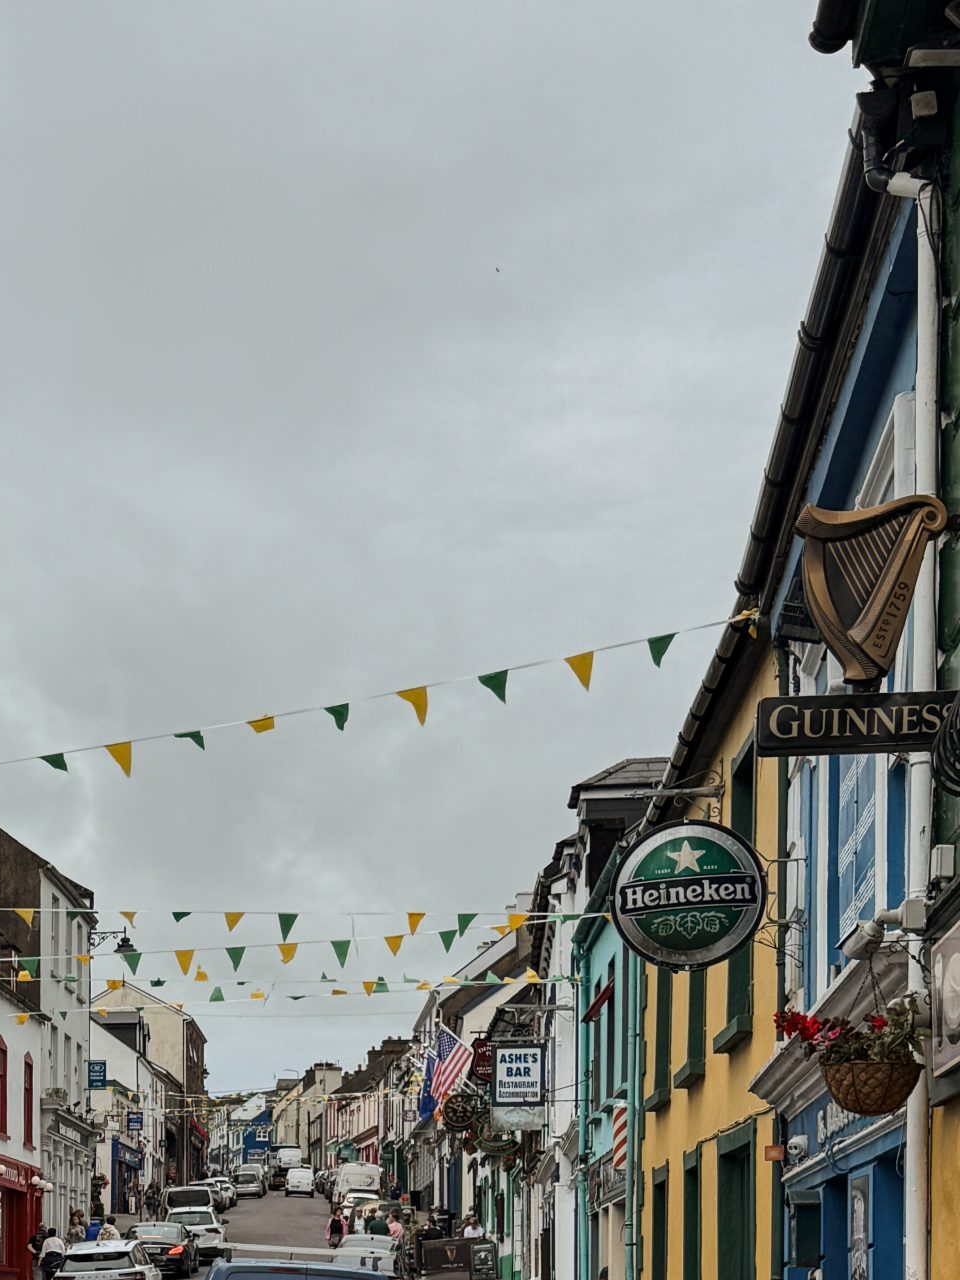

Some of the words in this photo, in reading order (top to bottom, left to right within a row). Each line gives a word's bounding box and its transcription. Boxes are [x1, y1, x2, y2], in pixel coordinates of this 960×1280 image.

[887, 581, 910, 619] 1759
[625, 880, 752, 909] Heineken
[499, 1053, 538, 1064] ASHE'S
[506, 1066, 531, 1077] BAR
